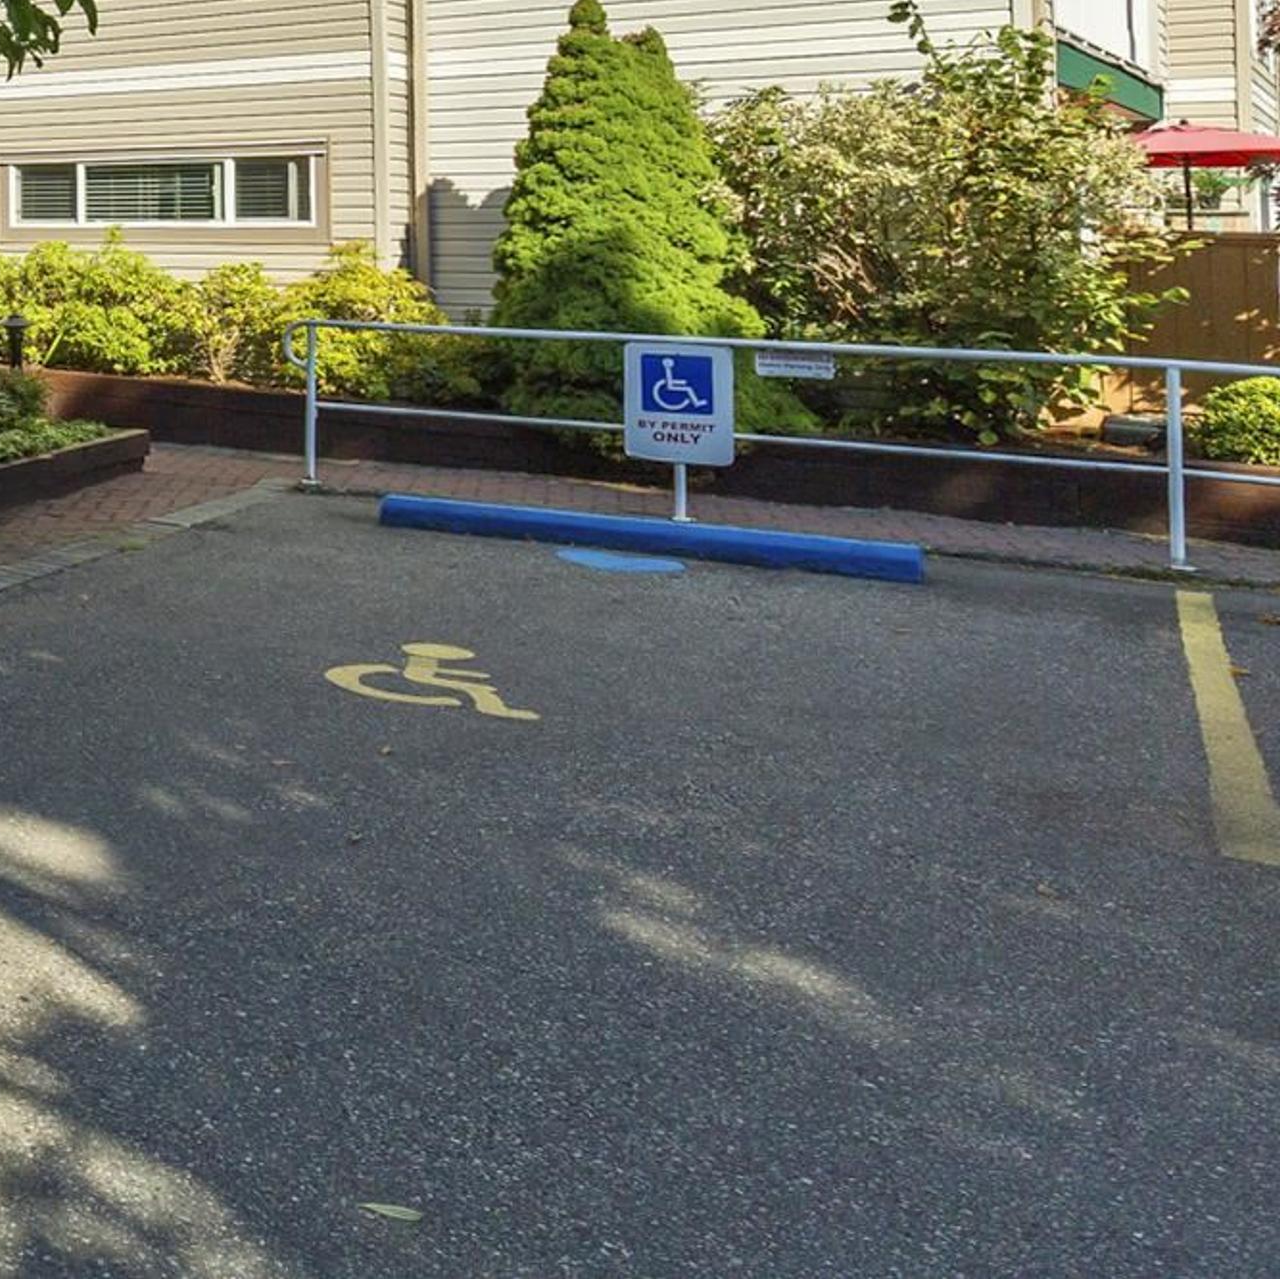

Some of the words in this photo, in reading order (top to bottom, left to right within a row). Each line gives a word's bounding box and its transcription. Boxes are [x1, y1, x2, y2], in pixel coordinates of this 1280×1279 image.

[637, 419, 657, 429] BY
[661, 421, 716, 433] PERMIT
[652, 431, 702, 445] ONLY
